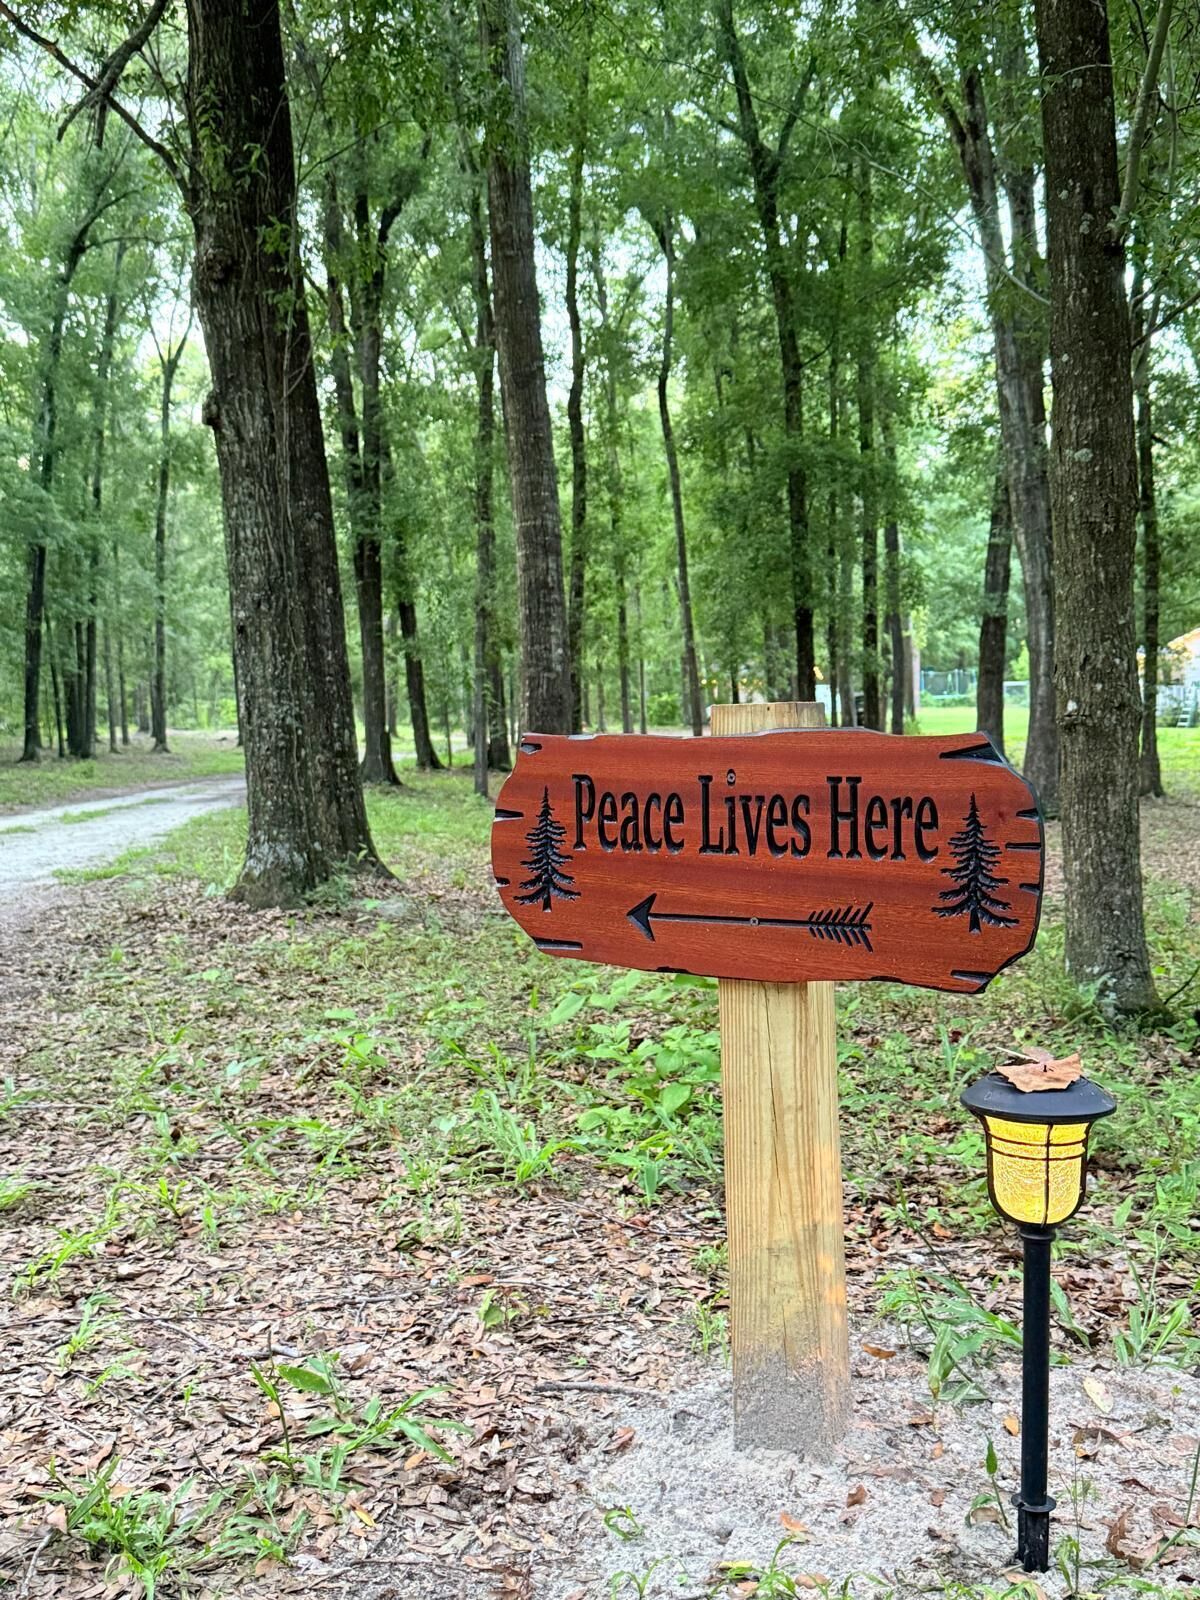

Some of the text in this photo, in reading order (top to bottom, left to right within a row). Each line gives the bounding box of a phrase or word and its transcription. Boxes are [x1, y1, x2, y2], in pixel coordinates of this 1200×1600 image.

[572, 769, 939, 863] Peace Lives Here
